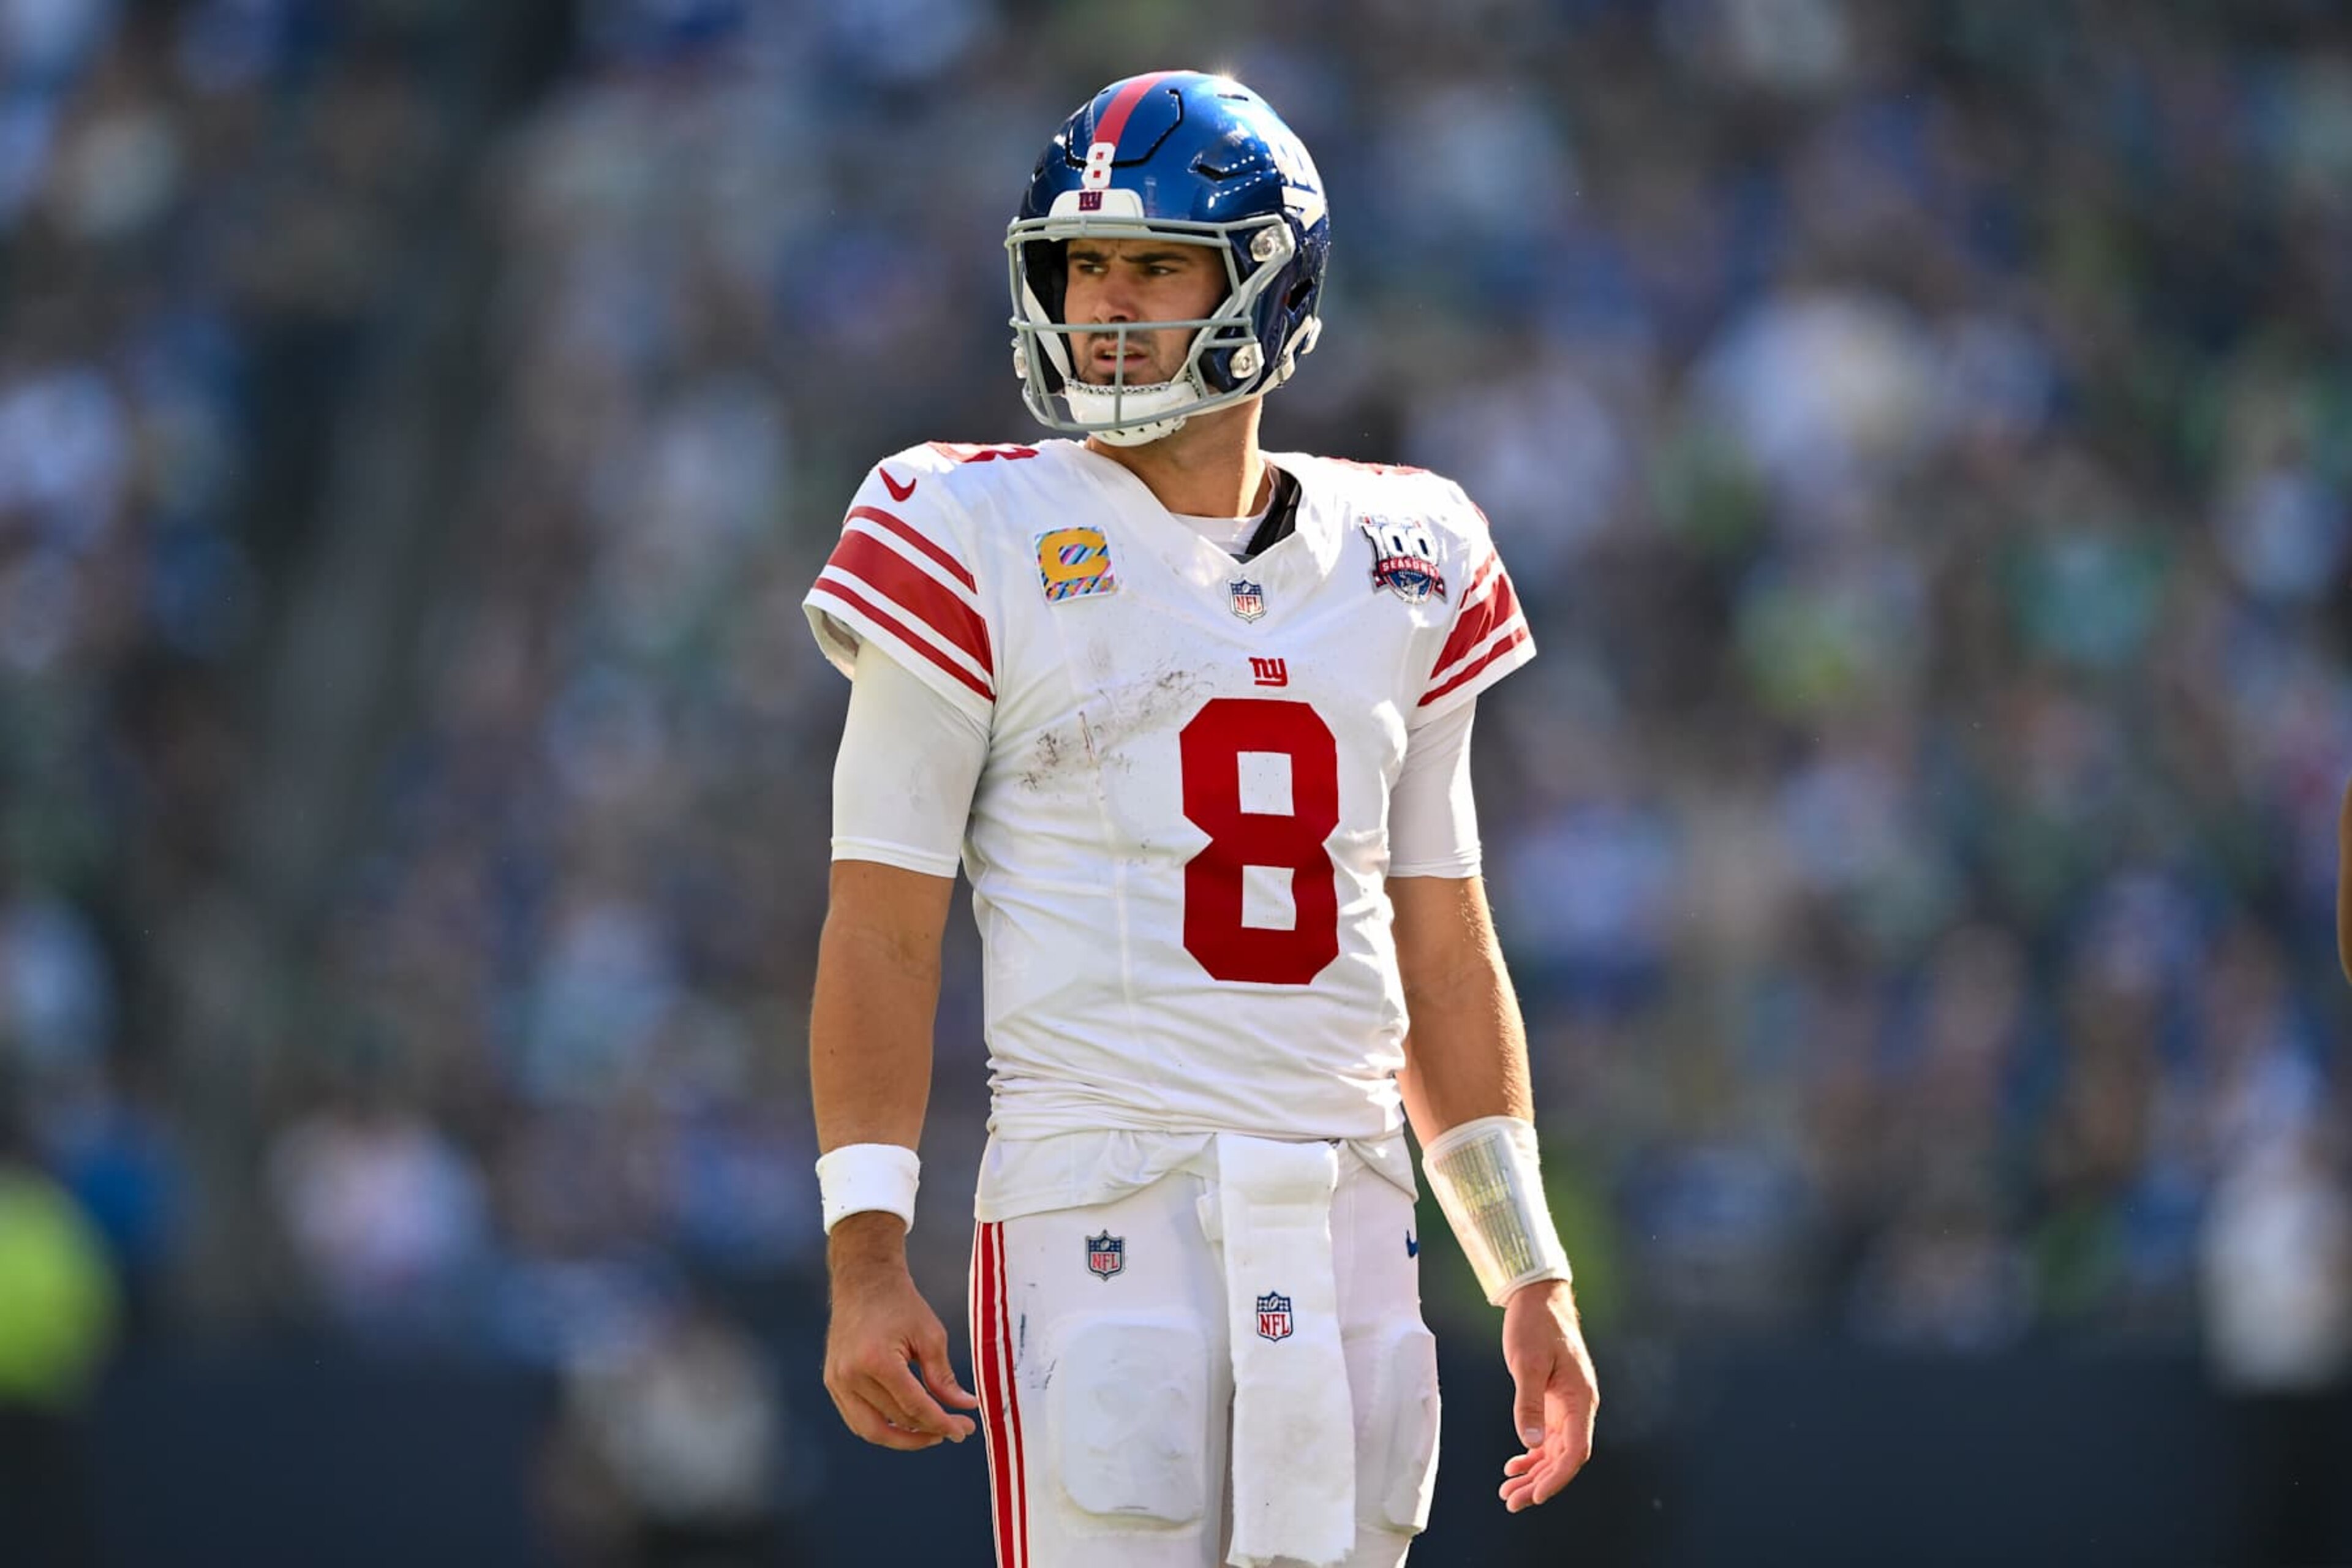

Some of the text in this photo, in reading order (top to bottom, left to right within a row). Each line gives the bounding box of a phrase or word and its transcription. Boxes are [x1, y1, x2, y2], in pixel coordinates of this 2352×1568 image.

[1082, 142, 1116, 189] 8
[1039, 529, 1110, 582] C
[1360, 524, 1438, 565] 100
[1235, 595, 1262, 613] NFL
[1180, 698, 1340, 984] 8
[1092, 1253, 1118, 1272] NFL
[1259, 1314, 1289, 1336] NFL
